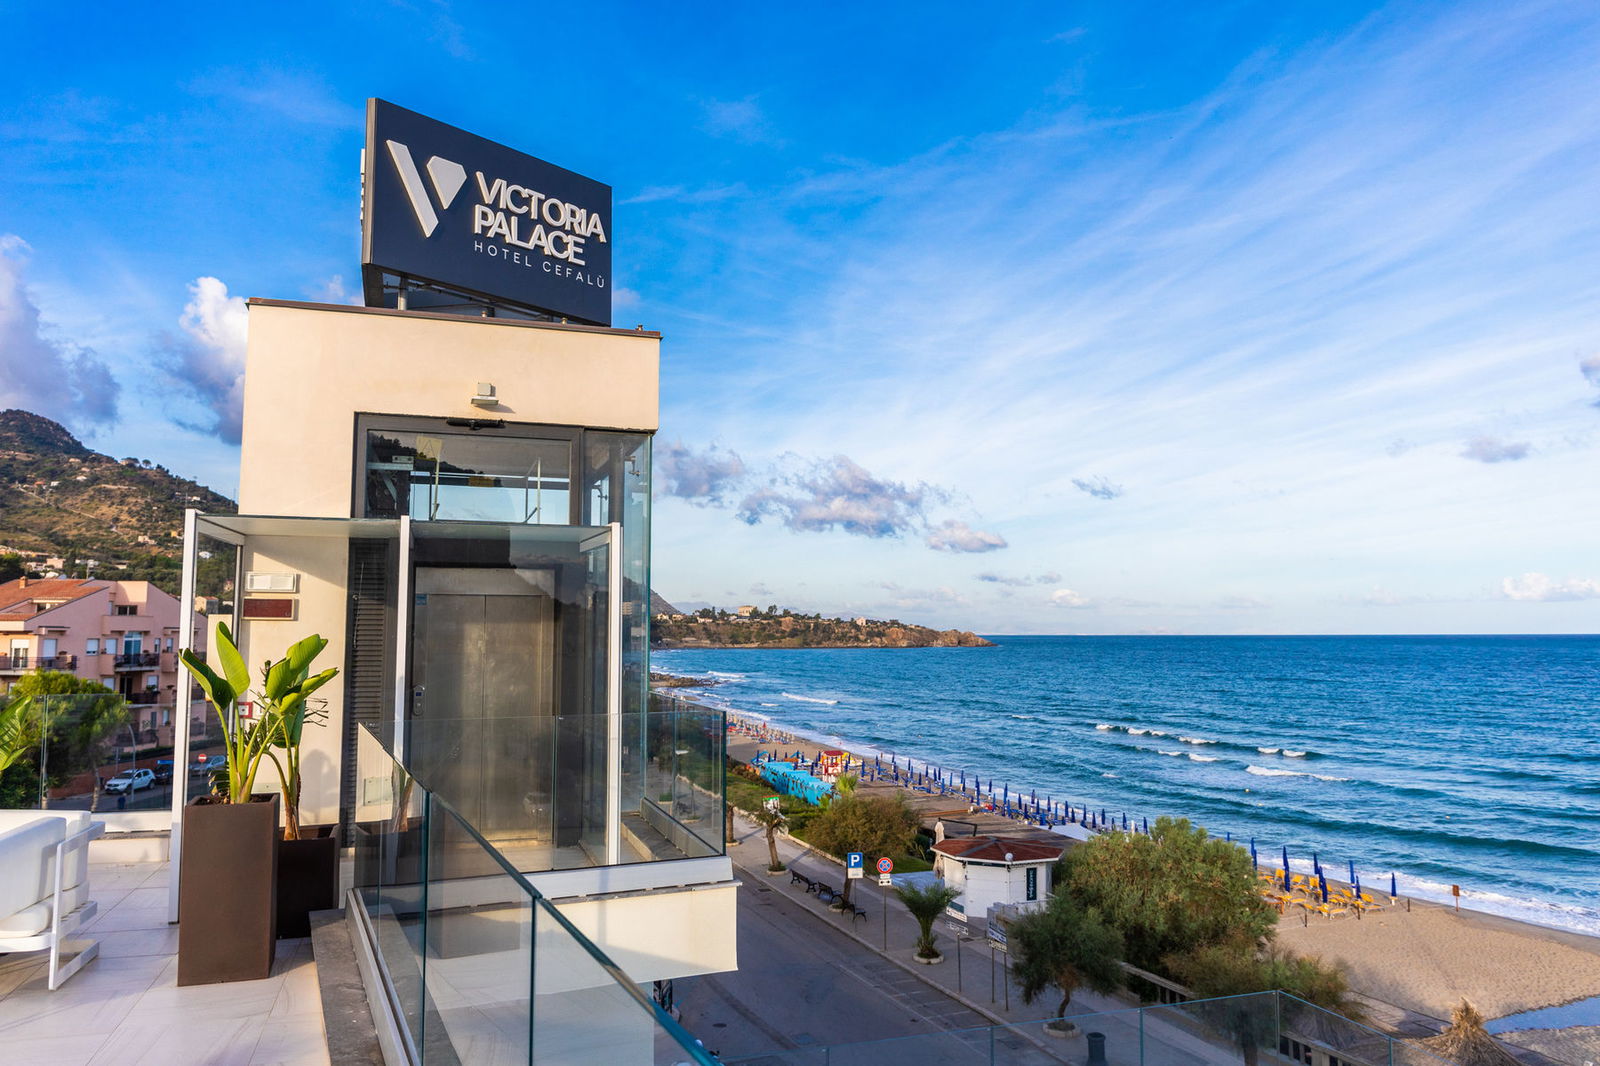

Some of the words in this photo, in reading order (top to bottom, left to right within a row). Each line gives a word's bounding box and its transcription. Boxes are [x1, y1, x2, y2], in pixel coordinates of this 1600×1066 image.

[474, 203, 586, 266] PALACE
[475, 171, 607, 243] VICTORIA
[474, 240, 532, 267] HOTEL
[542, 261, 605, 288] CEFALÙ
[850, 854, 860, 867] P
